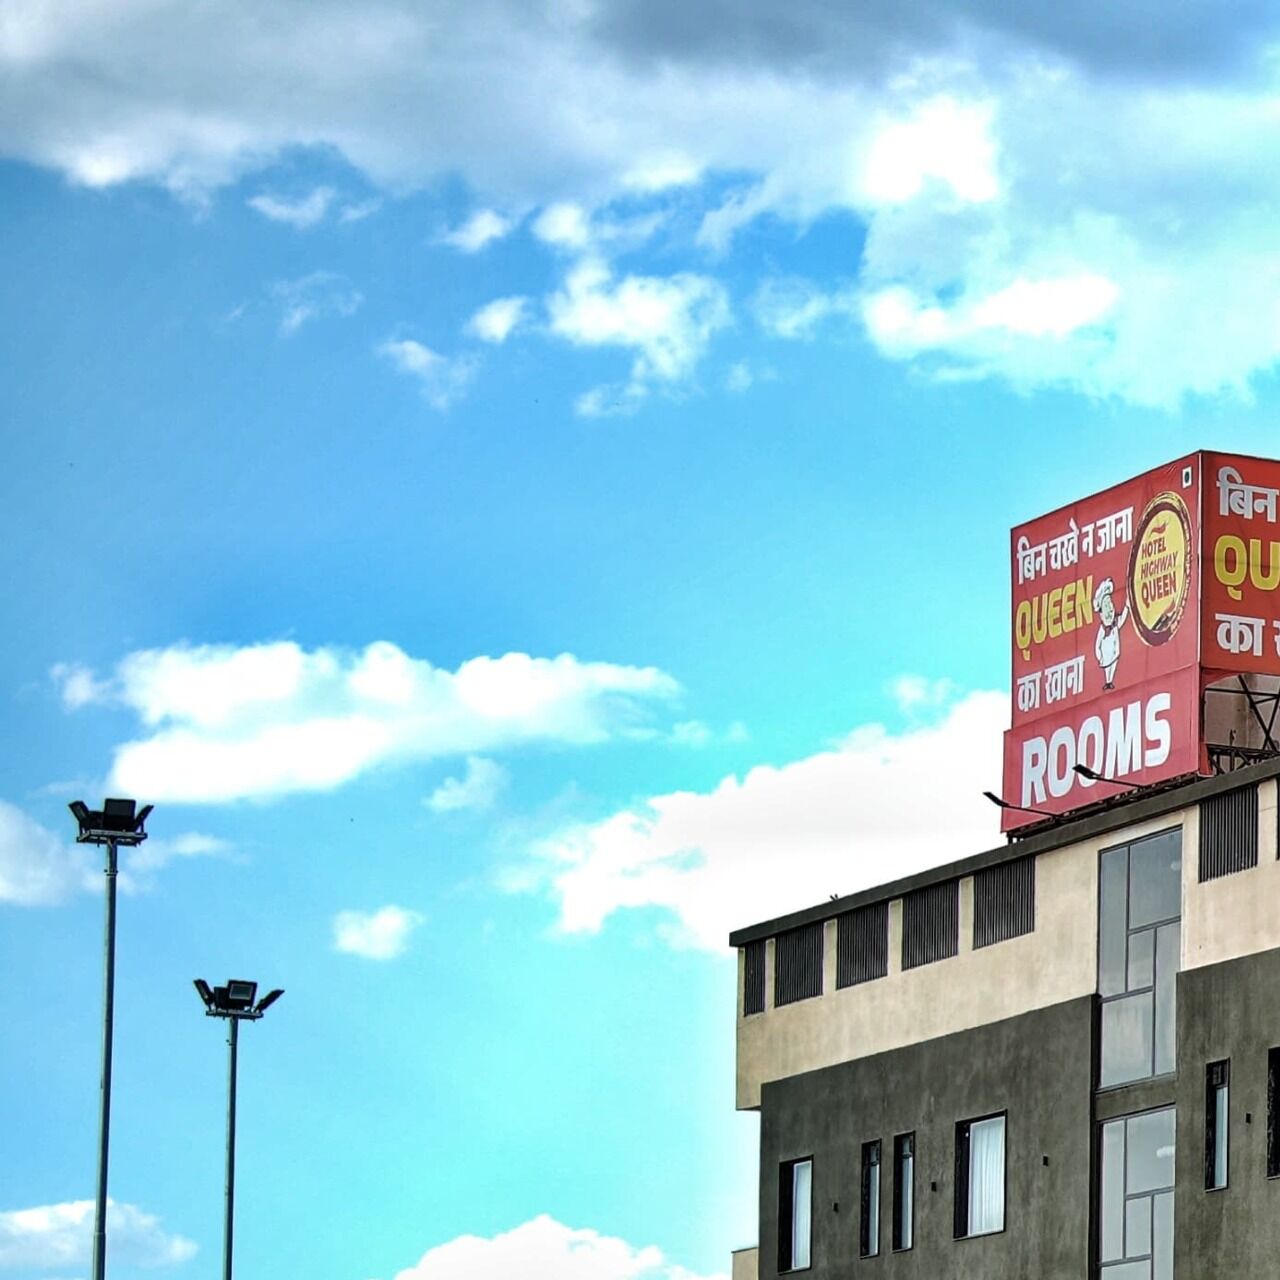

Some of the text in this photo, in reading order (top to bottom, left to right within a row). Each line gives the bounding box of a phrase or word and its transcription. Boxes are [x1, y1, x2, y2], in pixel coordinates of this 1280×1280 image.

[1216, 466, 1279, 523] बिन
[1017, 506, 1134, 585] बिन चखे न जाना
[1140, 551, 1178, 580] HIGHWAY
[1141, 536, 1167, 560] HOTEL
[1015, 575, 1094, 661] QUEEN
[1141, 571, 1176, 609] QUEEN
[1215, 613, 1265, 656] का
[1017, 656, 1086, 712] का खाना
[1021, 693, 1171, 808] ROOMS
